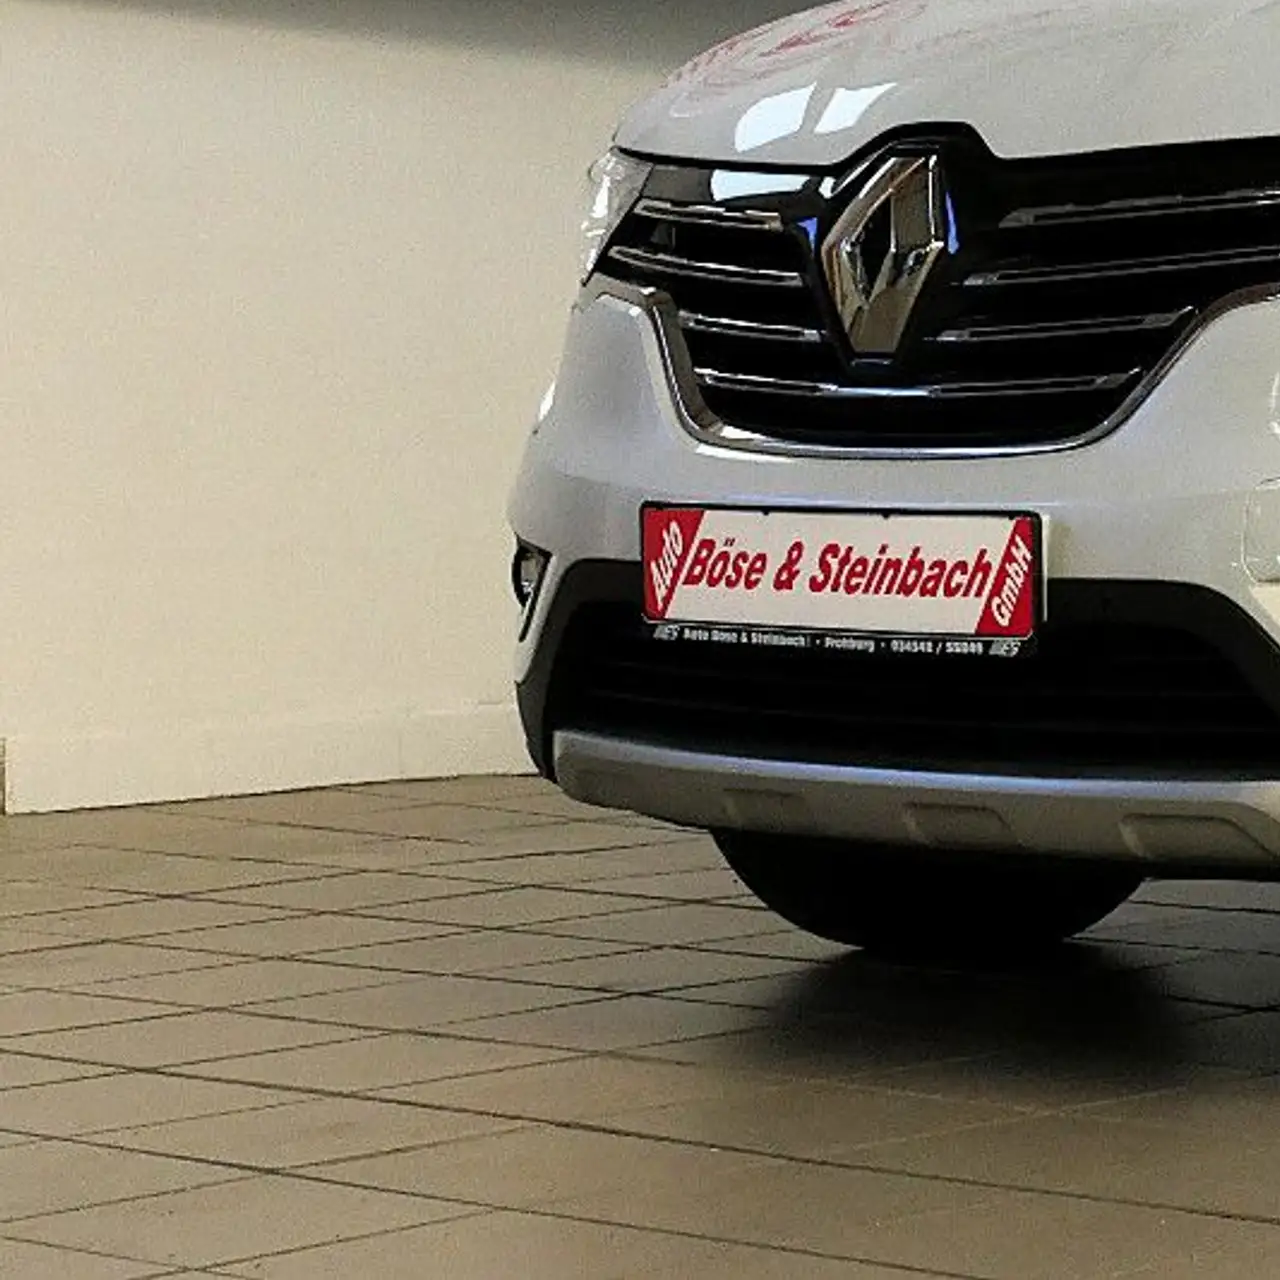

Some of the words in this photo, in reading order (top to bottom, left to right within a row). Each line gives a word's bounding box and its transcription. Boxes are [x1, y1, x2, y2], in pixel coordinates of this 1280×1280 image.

[649, 520, 685, 611] Auto
[682, 538, 768, 588] Böse
[773, 540, 804, 592] &
[809, 543, 993, 598] Steinbach
[992, 535, 1033, 627] GmbH
